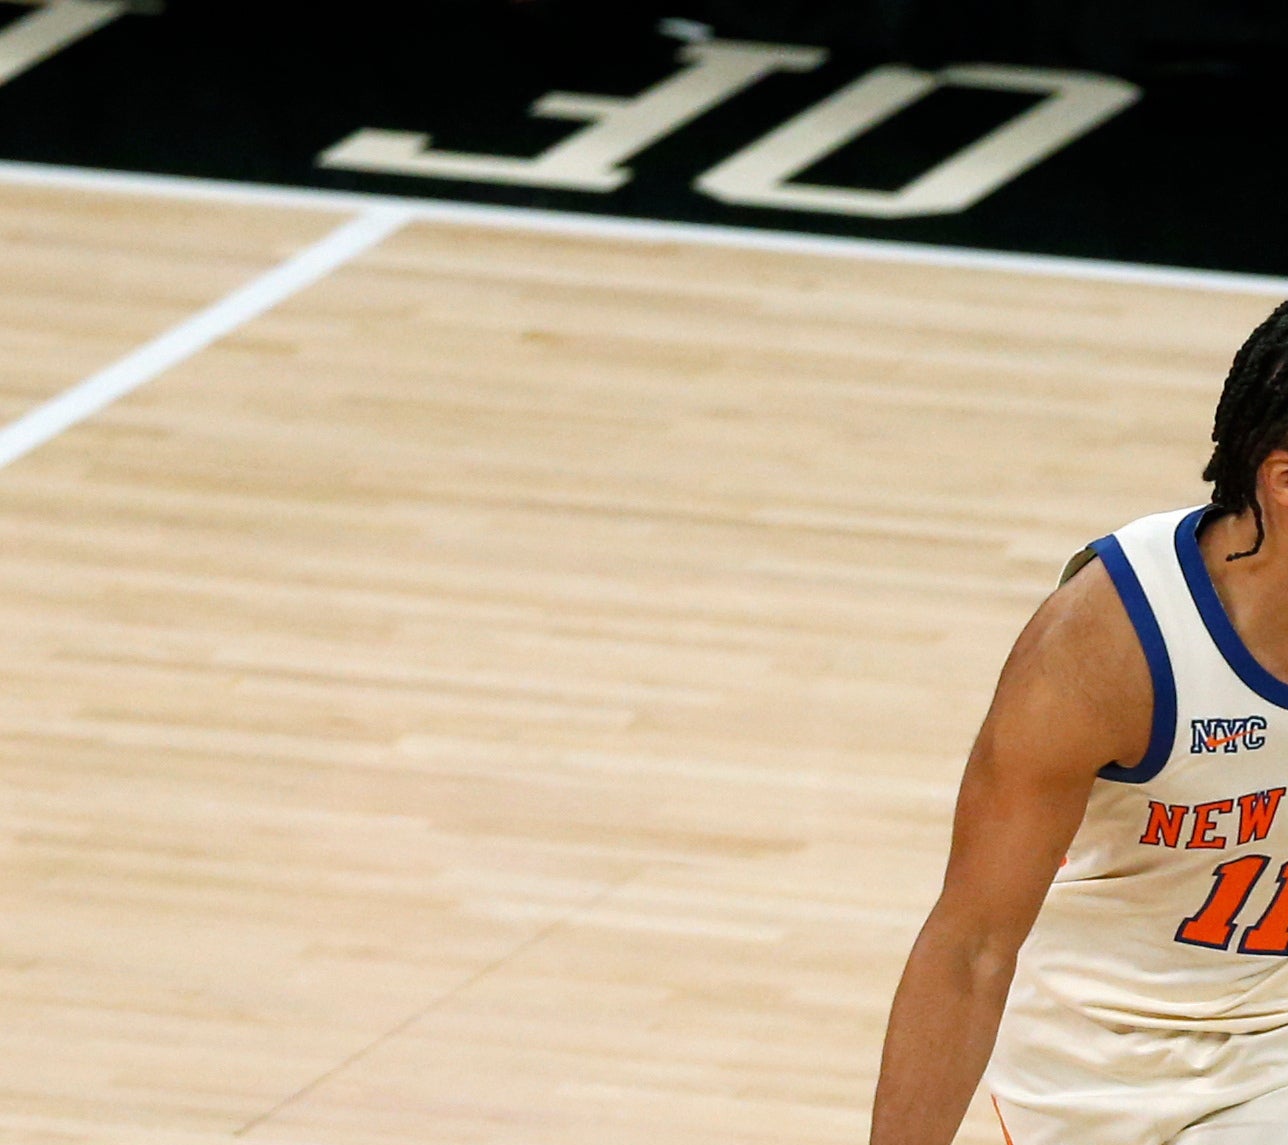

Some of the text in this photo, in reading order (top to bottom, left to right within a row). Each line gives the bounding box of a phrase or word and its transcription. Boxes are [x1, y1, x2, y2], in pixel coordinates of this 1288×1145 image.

[317, 38, 1144, 219] OF
[1190, 716, 1267, 754] NYC
[1139, 786, 1287, 850] NEW
